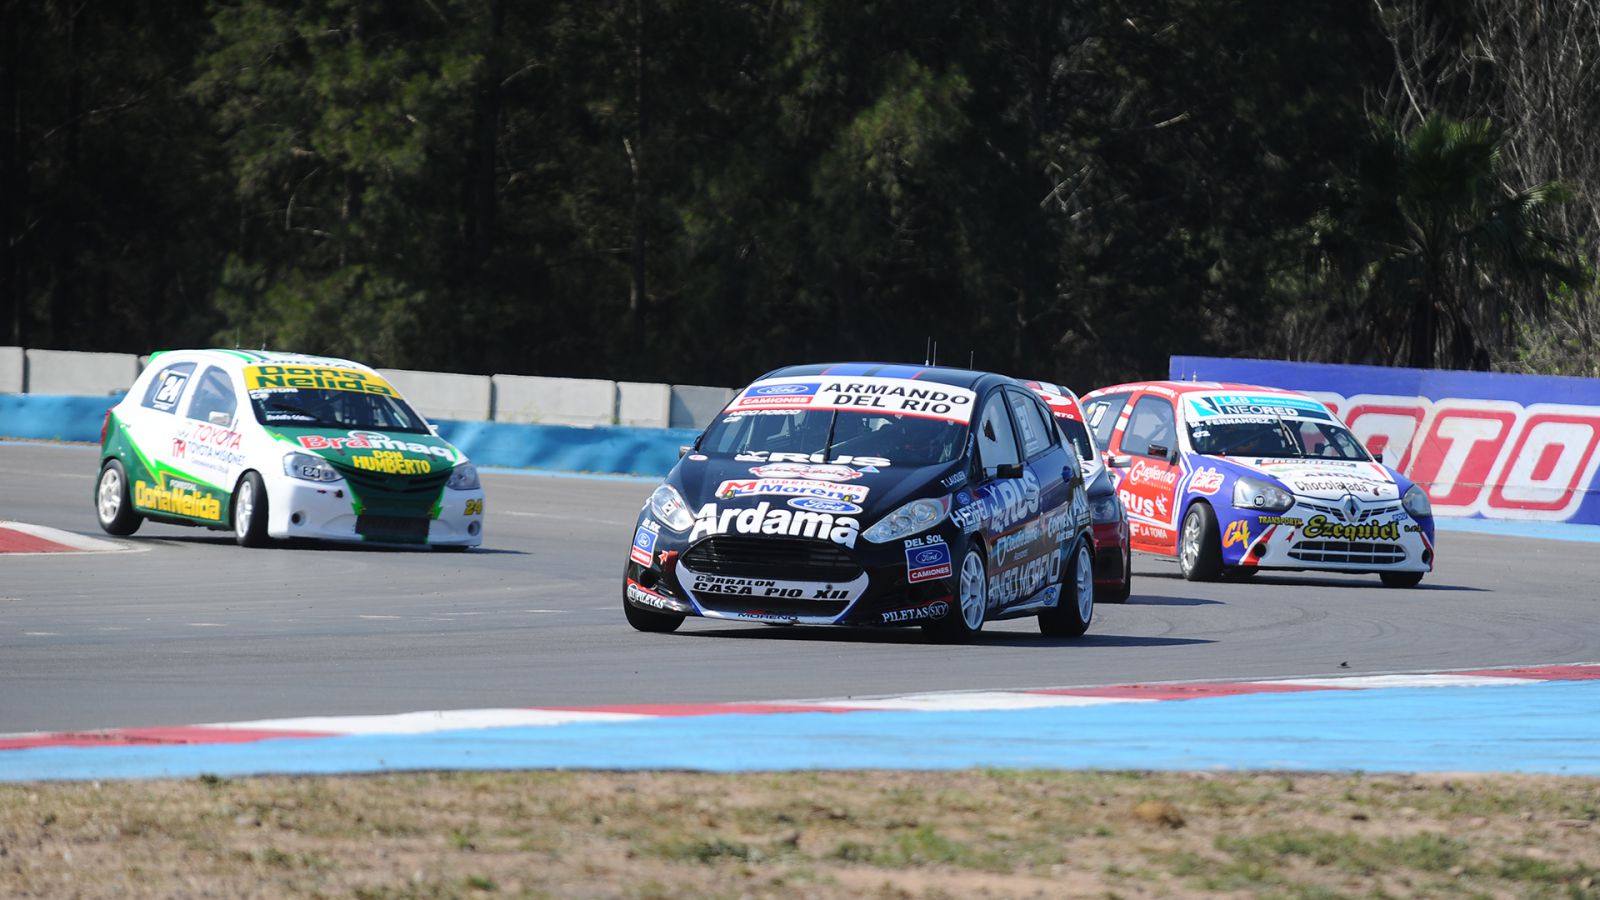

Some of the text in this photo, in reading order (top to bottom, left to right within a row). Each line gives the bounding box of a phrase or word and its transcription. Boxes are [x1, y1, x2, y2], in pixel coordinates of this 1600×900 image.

[157, 376, 185, 402] 24
[256, 377, 392, 395] Nelida
[824, 383, 970, 406] ARMANDO
[833, 395, 951, 414] DEL RIO
[1227, 406, 1299, 417] NEORED
[1206, 419, 1272, 428] FERNANDEZ
[194, 424, 242, 448] TOYOTA
[297, 434, 457, 462] Bramaq
[372, 450, 404, 460] DON
[304, 467, 320, 477] 24
[352, 455, 431, 474] HUMBERTO
[759, 484, 861, 501] Moreno
[763, 479, 863, 492] LUBRICANTES
[464, 499, 483, 515] 24
[797, 498, 850, 513] Ford
[1120, 489, 1155, 517] RUS
[688, 502, 860, 549] Ardama
[1140, 526, 1168, 539] LA TOMA
[1303, 514, 1400, 541] Ezequiel
[904, 534, 944, 549] DEL SOL
[918, 551, 940, 562] Ford
[912, 566, 950, 579] CAMIONES
[695, 575, 775, 587] CORRALON
[693, 582, 849, 600] CASA PIO XII
[737, 612, 798, 621] MORENO
[882, 603, 948, 622] PILETAS SKY
